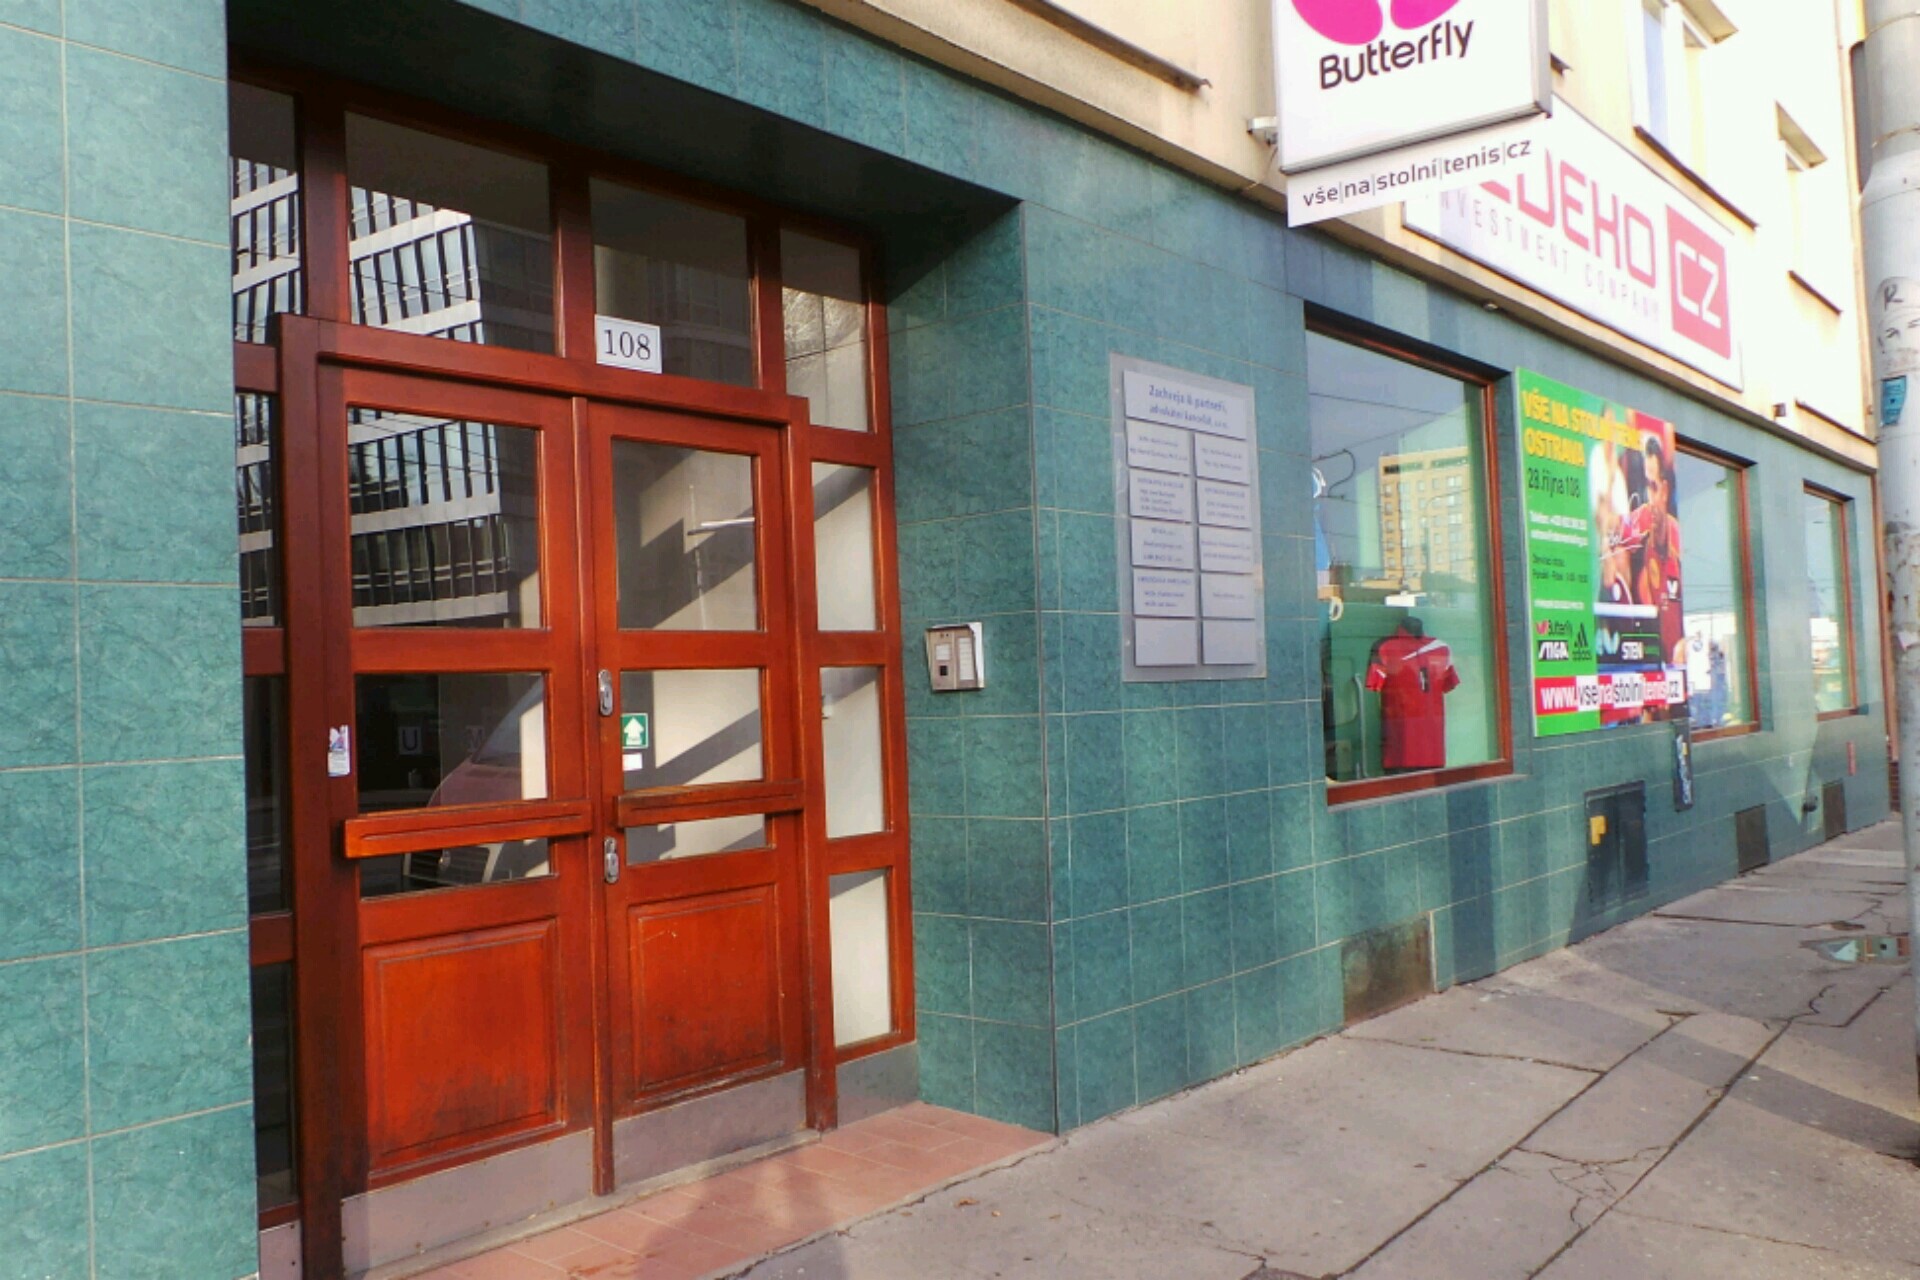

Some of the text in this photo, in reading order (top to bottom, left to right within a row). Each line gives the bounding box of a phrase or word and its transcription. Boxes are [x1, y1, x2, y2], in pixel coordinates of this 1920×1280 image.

[1319, 20, 1474, 90] Butterfly
[1674, 239, 1722, 330] CZ
[604, 329, 651, 361] 108
